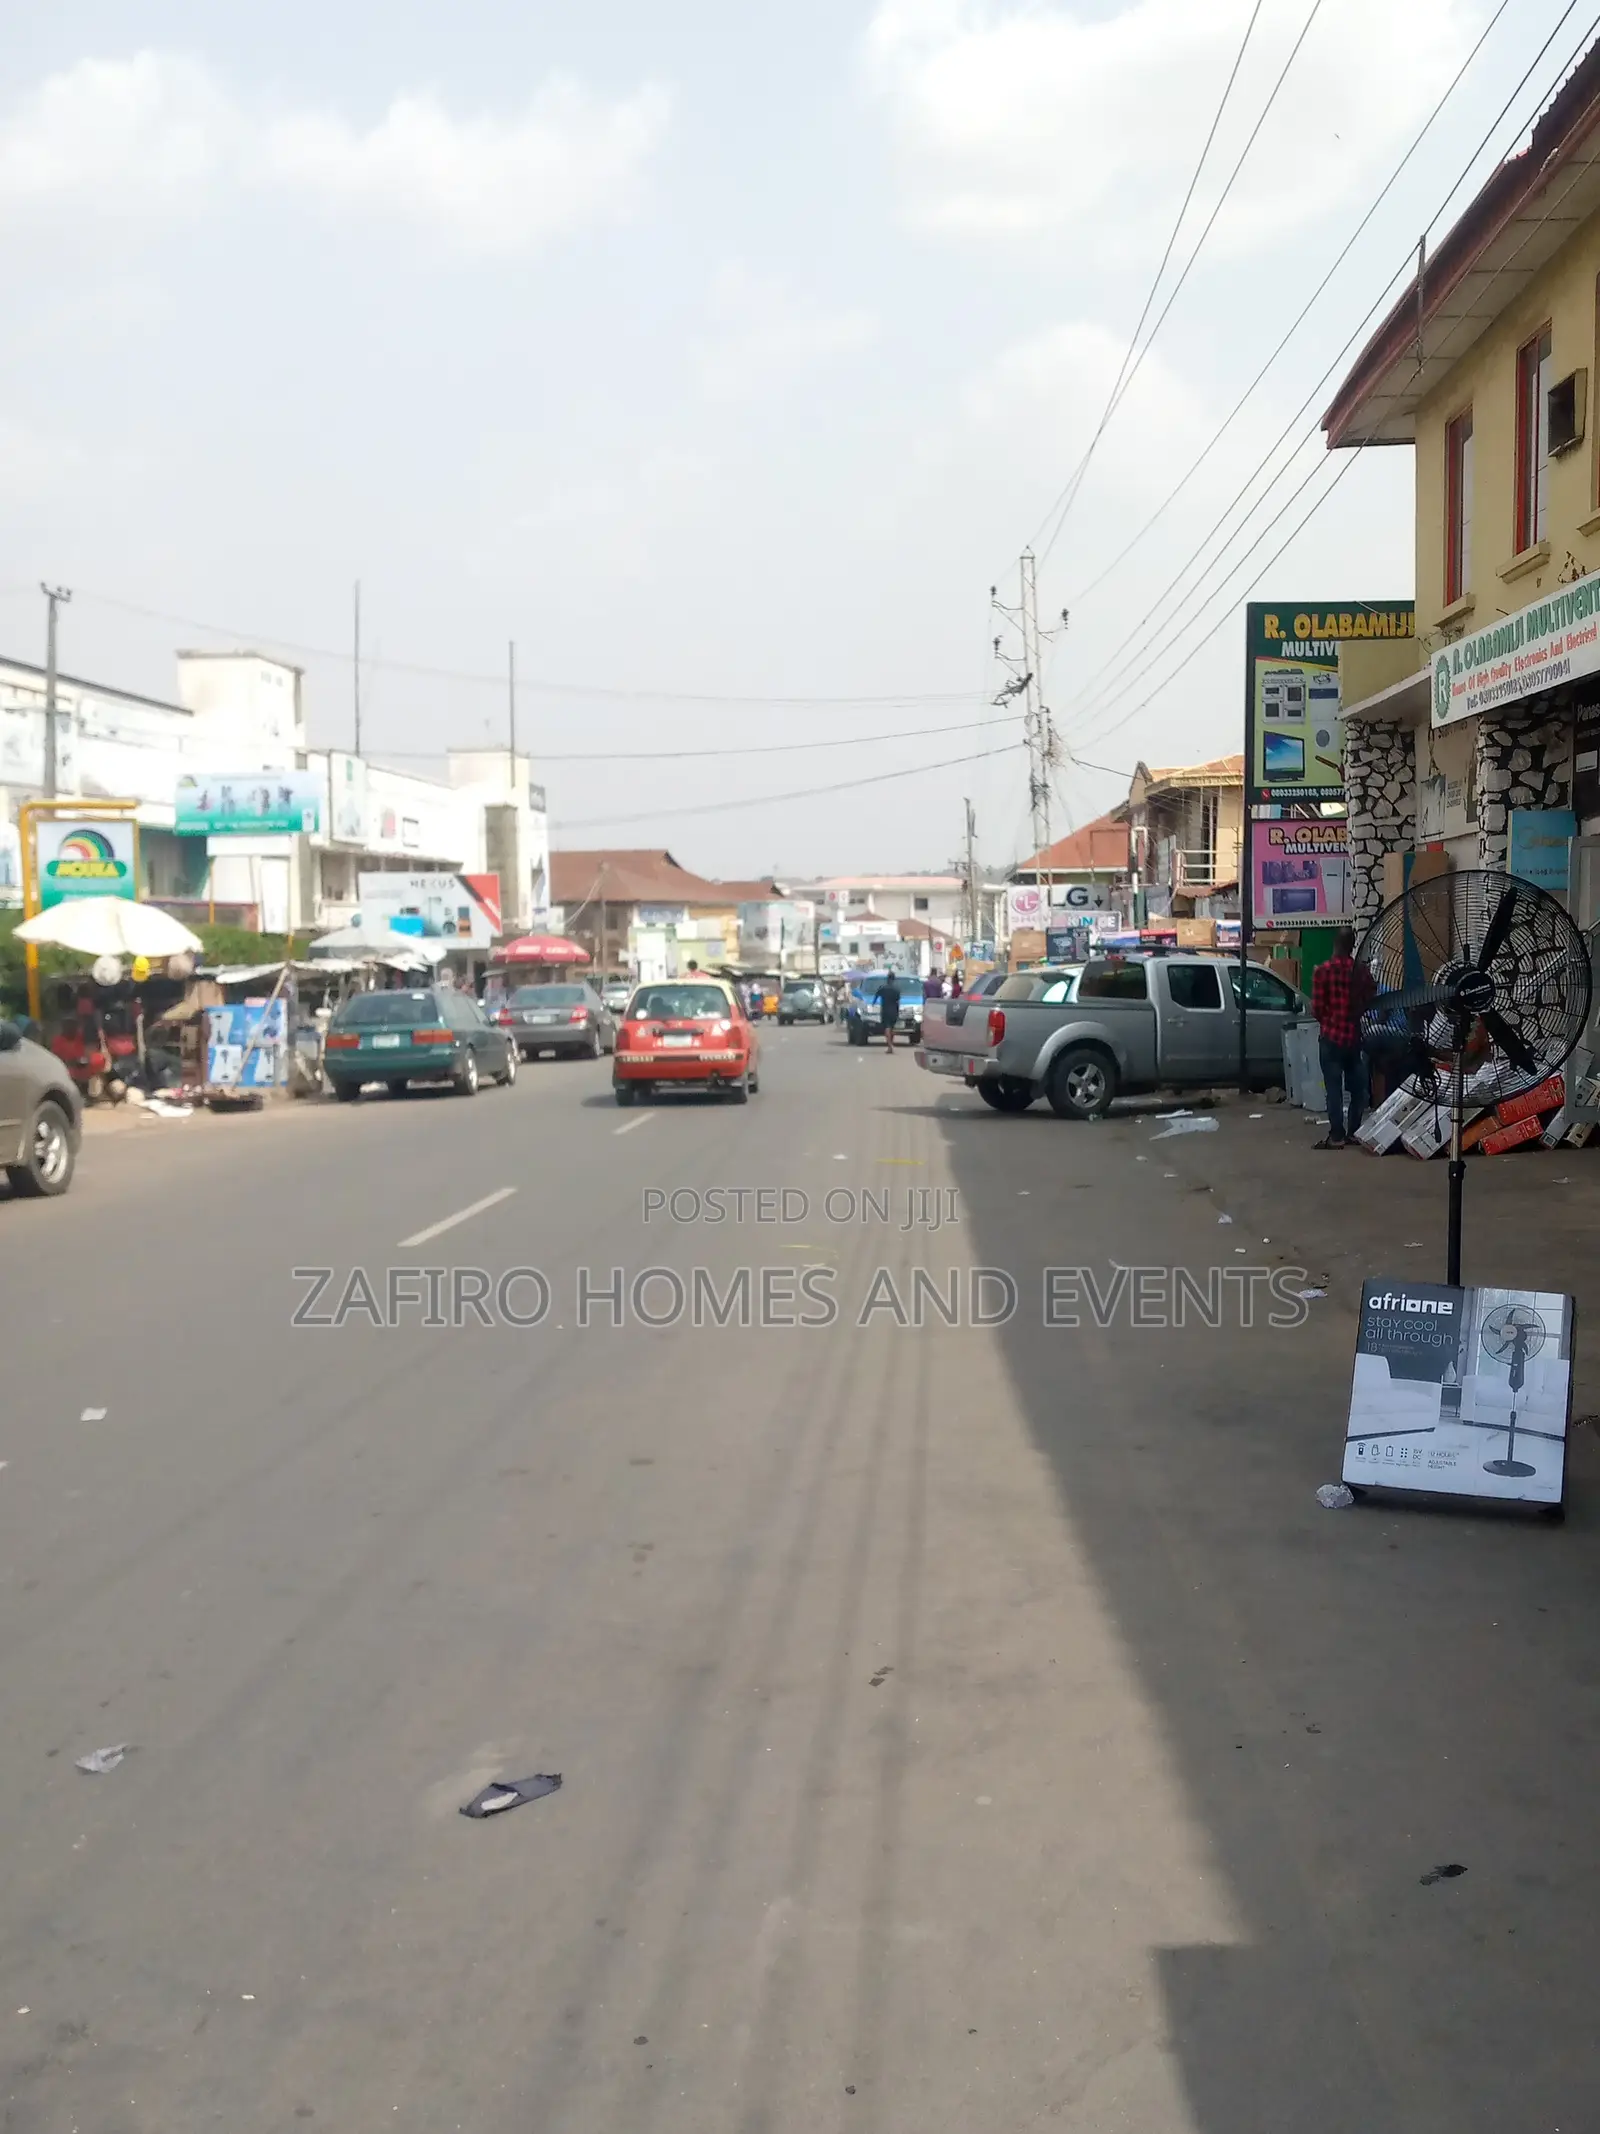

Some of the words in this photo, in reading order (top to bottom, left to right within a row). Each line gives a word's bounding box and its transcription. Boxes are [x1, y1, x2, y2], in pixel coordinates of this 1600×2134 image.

[1264, 614, 1287, 639] R.
[1294, 612, 1415, 639] OLABAMIJI
[1464, 615, 1525, 670] OLABAMIJI
[1477, 669, 1489, 688] High
[1491, 661, 1511, 683] Quality
[1515, 647, 1548, 672] Electronics
[1550, 637, 1563, 658] And
[1566, 621, 1597, 651] Electrical
[1269, 828, 1289, 845] R.
[1047, 887, 1088, 907] LG
[1367, 1315, 1401, 1329] stay
[1403, 1320, 1438, 1332] cool
[1365, 1328, 1383, 1339] all
[1387, 1329, 1453, 1348] through
